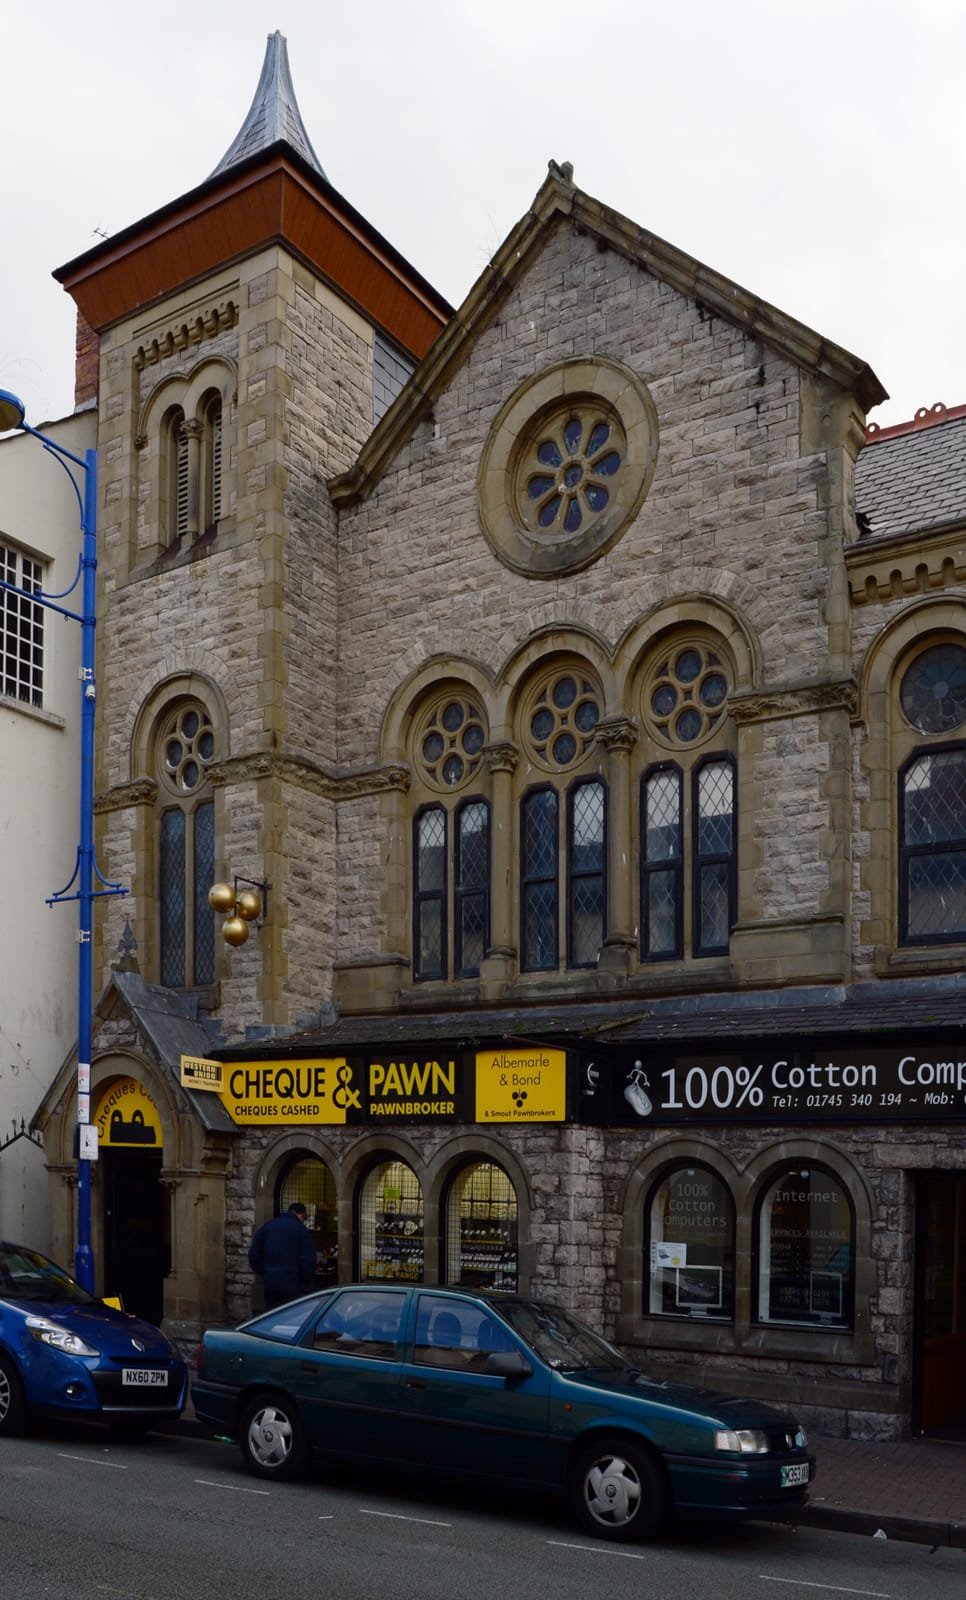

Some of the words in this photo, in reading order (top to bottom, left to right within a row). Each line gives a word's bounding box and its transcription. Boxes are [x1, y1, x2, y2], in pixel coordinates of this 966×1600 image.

[184, 1061, 216, 1073] WESTERN
[491, 1054, 550, 1069] Albemarle
[193, 1069, 216, 1080] UNION
[499, 1075, 509, 1087] &
[512, 1071, 541, 1086] Bond
[229, 1066, 326, 1099] CHEQUE
[332, 1064, 362, 1109] &
[369, 1060, 455, 1097] PAWN
[660, 1064, 764, 1109] 100%
[771, 1060, 877, 1089] Cotton
[772, 1094, 799, 1108] Tel:
[806, 1094, 843, 1107] 01745
[850, 1093, 873, 1106] 340
[879, 1093, 902, 1106] 194
[924, 1091, 955, 1105] Mob:
[234, 1105, 278, 1116] CHEQUES
[281, 1104, 320, 1116] CASHED
[370, 1101, 455, 1115] PAWNBROKER
[513, 1109, 556, 1117] Pawnbrokers
[677, 1183, 709, 1197] 100%
[774, 1189, 839, 1204] Internet
[668, 1200, 716, 1213] Cotton
[661, 1215, 728, 1229] omputers
[126, 1370, 149, 1383] NX60
